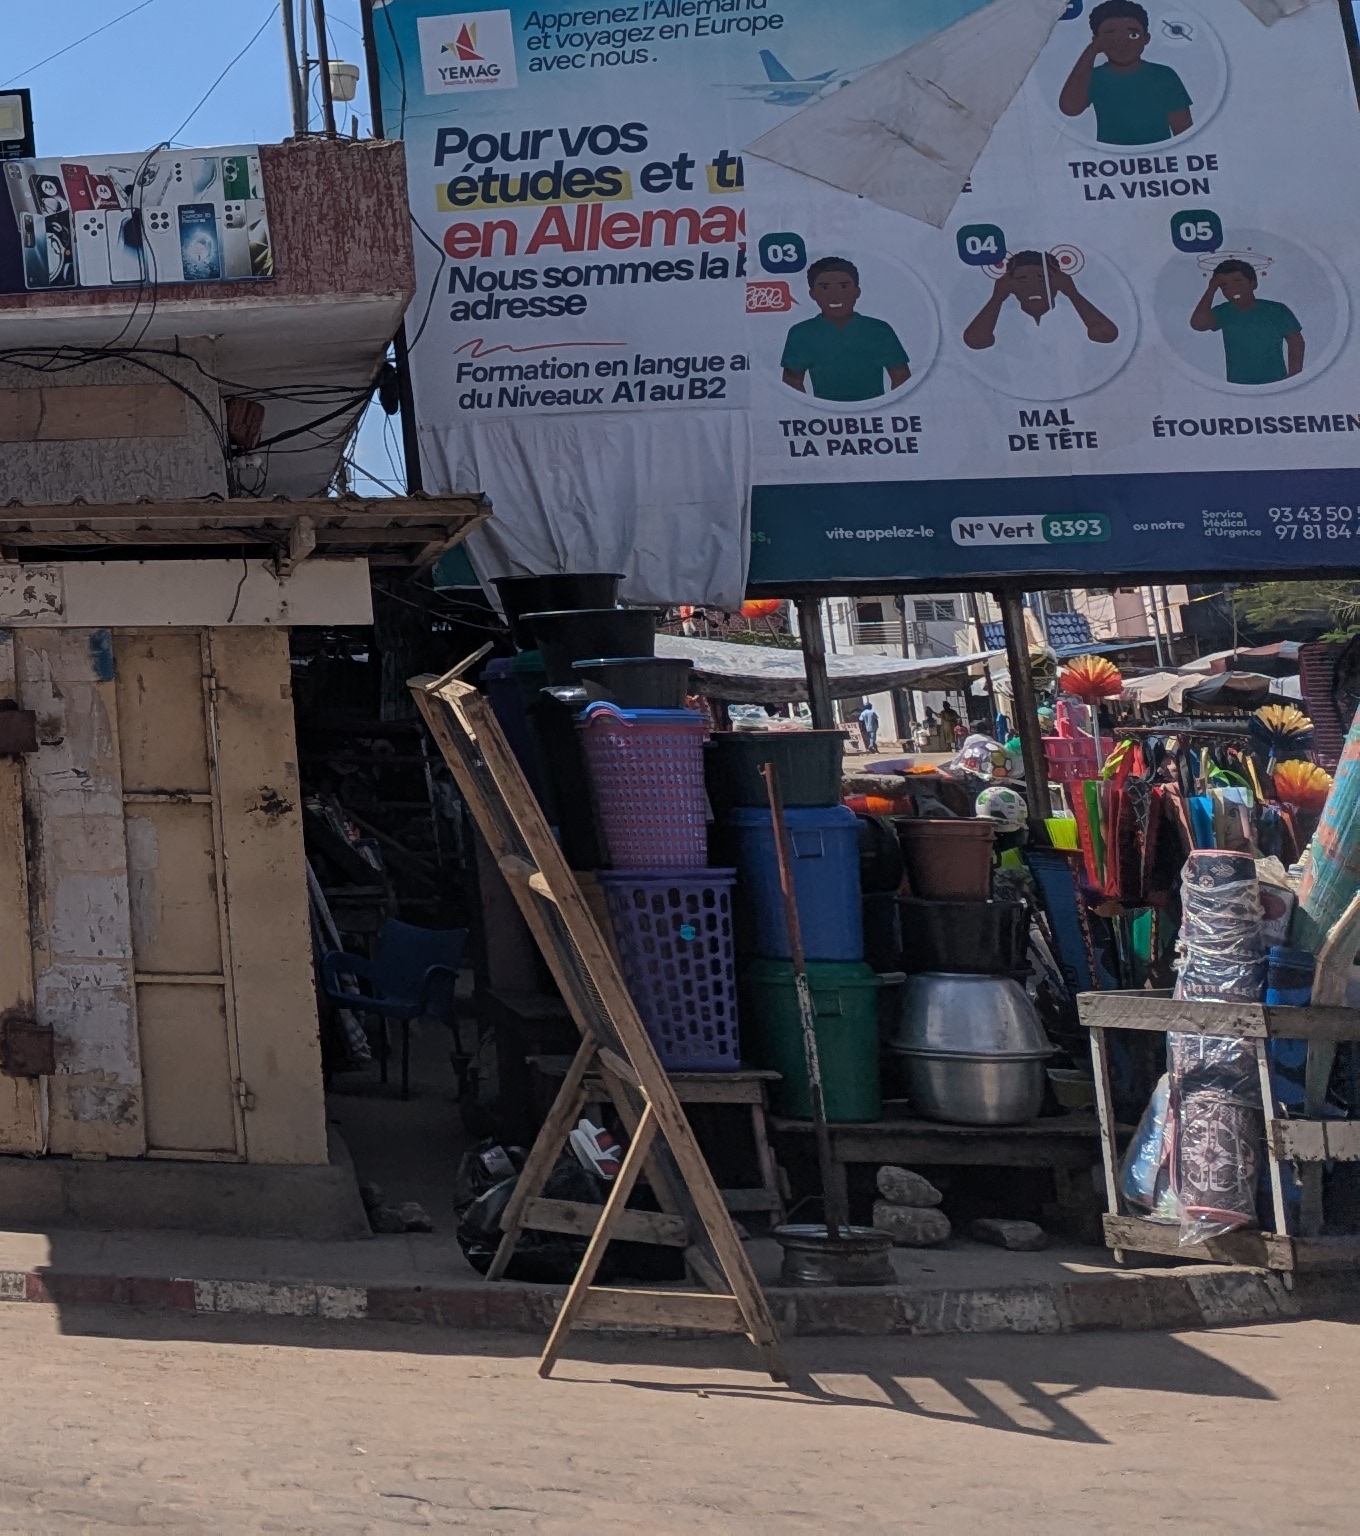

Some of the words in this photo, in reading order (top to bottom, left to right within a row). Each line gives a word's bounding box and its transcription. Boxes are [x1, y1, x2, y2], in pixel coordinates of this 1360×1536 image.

[523, 6, 639, 31] Apprenez
[526, 31, 551, 50] et
[555, 22, 655, 49] voyagez
[659, 20, 688, 38] en
[695, 14, 784, 36] Europe
[438, 64, 501, 80] YEMAG
[529, 53, 585, 72] avec
[434, 127, 553, 166] Pour
[558, 122, 648, 156] vos
[1068, 156, 1179, 179] TROUBLE
[1186, 154, 1218, 171] DE
[446, 161, 624, 206] études
[640, 152, 695, 193] et
[1084, 182, 1116, 201] LA
[1120, 177, 1211, 198] VISION
[443, 219, 518, 259] en
[1179, 221, 1213, 241] 05
[767, 244, 798, 263] 03
[966, 236, 998, 255] 04
[448, 266, 537, 293] Nous
[542, 257, 695, 287] sommes
[698, 252, 729, 279] la
[450, 292, 588, 321] adresse
[456, 357, 590, 384] Formation
[594, 361, 628, 377] en
[634, 354, 725, 378] langue
[459, 388, 492, 409] du
[498, 385, 603, 408] Niveaux
[611, 380, 644, 403] A1
[649, 383, 684, 401] au
[688, 377, 726, 399] B2
[779, 416, 884, 437] TROUBLE
[891, 415, 922, 433] DE
[1019, 408, 1075, 428] MAL
[789, 439, 819, 458] LA
[827, 436, 919, 457] PAROLE
[1008, 434, 1039, 452] DE
[1045, 428, 1098, 450] TÊTE
[1202, 510, 1243, 519] Service
[1203, 518, 1247, 528] Médical
[1268, 508, 1292, 522] 93
[1297, 507, 1321, 521] 43
[1327, 506, 1352, 521] 50
[826, 526, 853, 539] vite
[856, 525, 934, 542] appelez-le
[987, 521, 1035, 538] Vert
[1049, 519, 1102, 537] 8393
[1133, 523, 1148, 531] ou
[1151, 520, 1185, 530] notre
[1204, 527, 1262, 539] d'Urgence
[1275, 524, 1297, 540] 97
[1302, 524, 1321, 539] 81
[1327, 524, 1351, 538] 84
